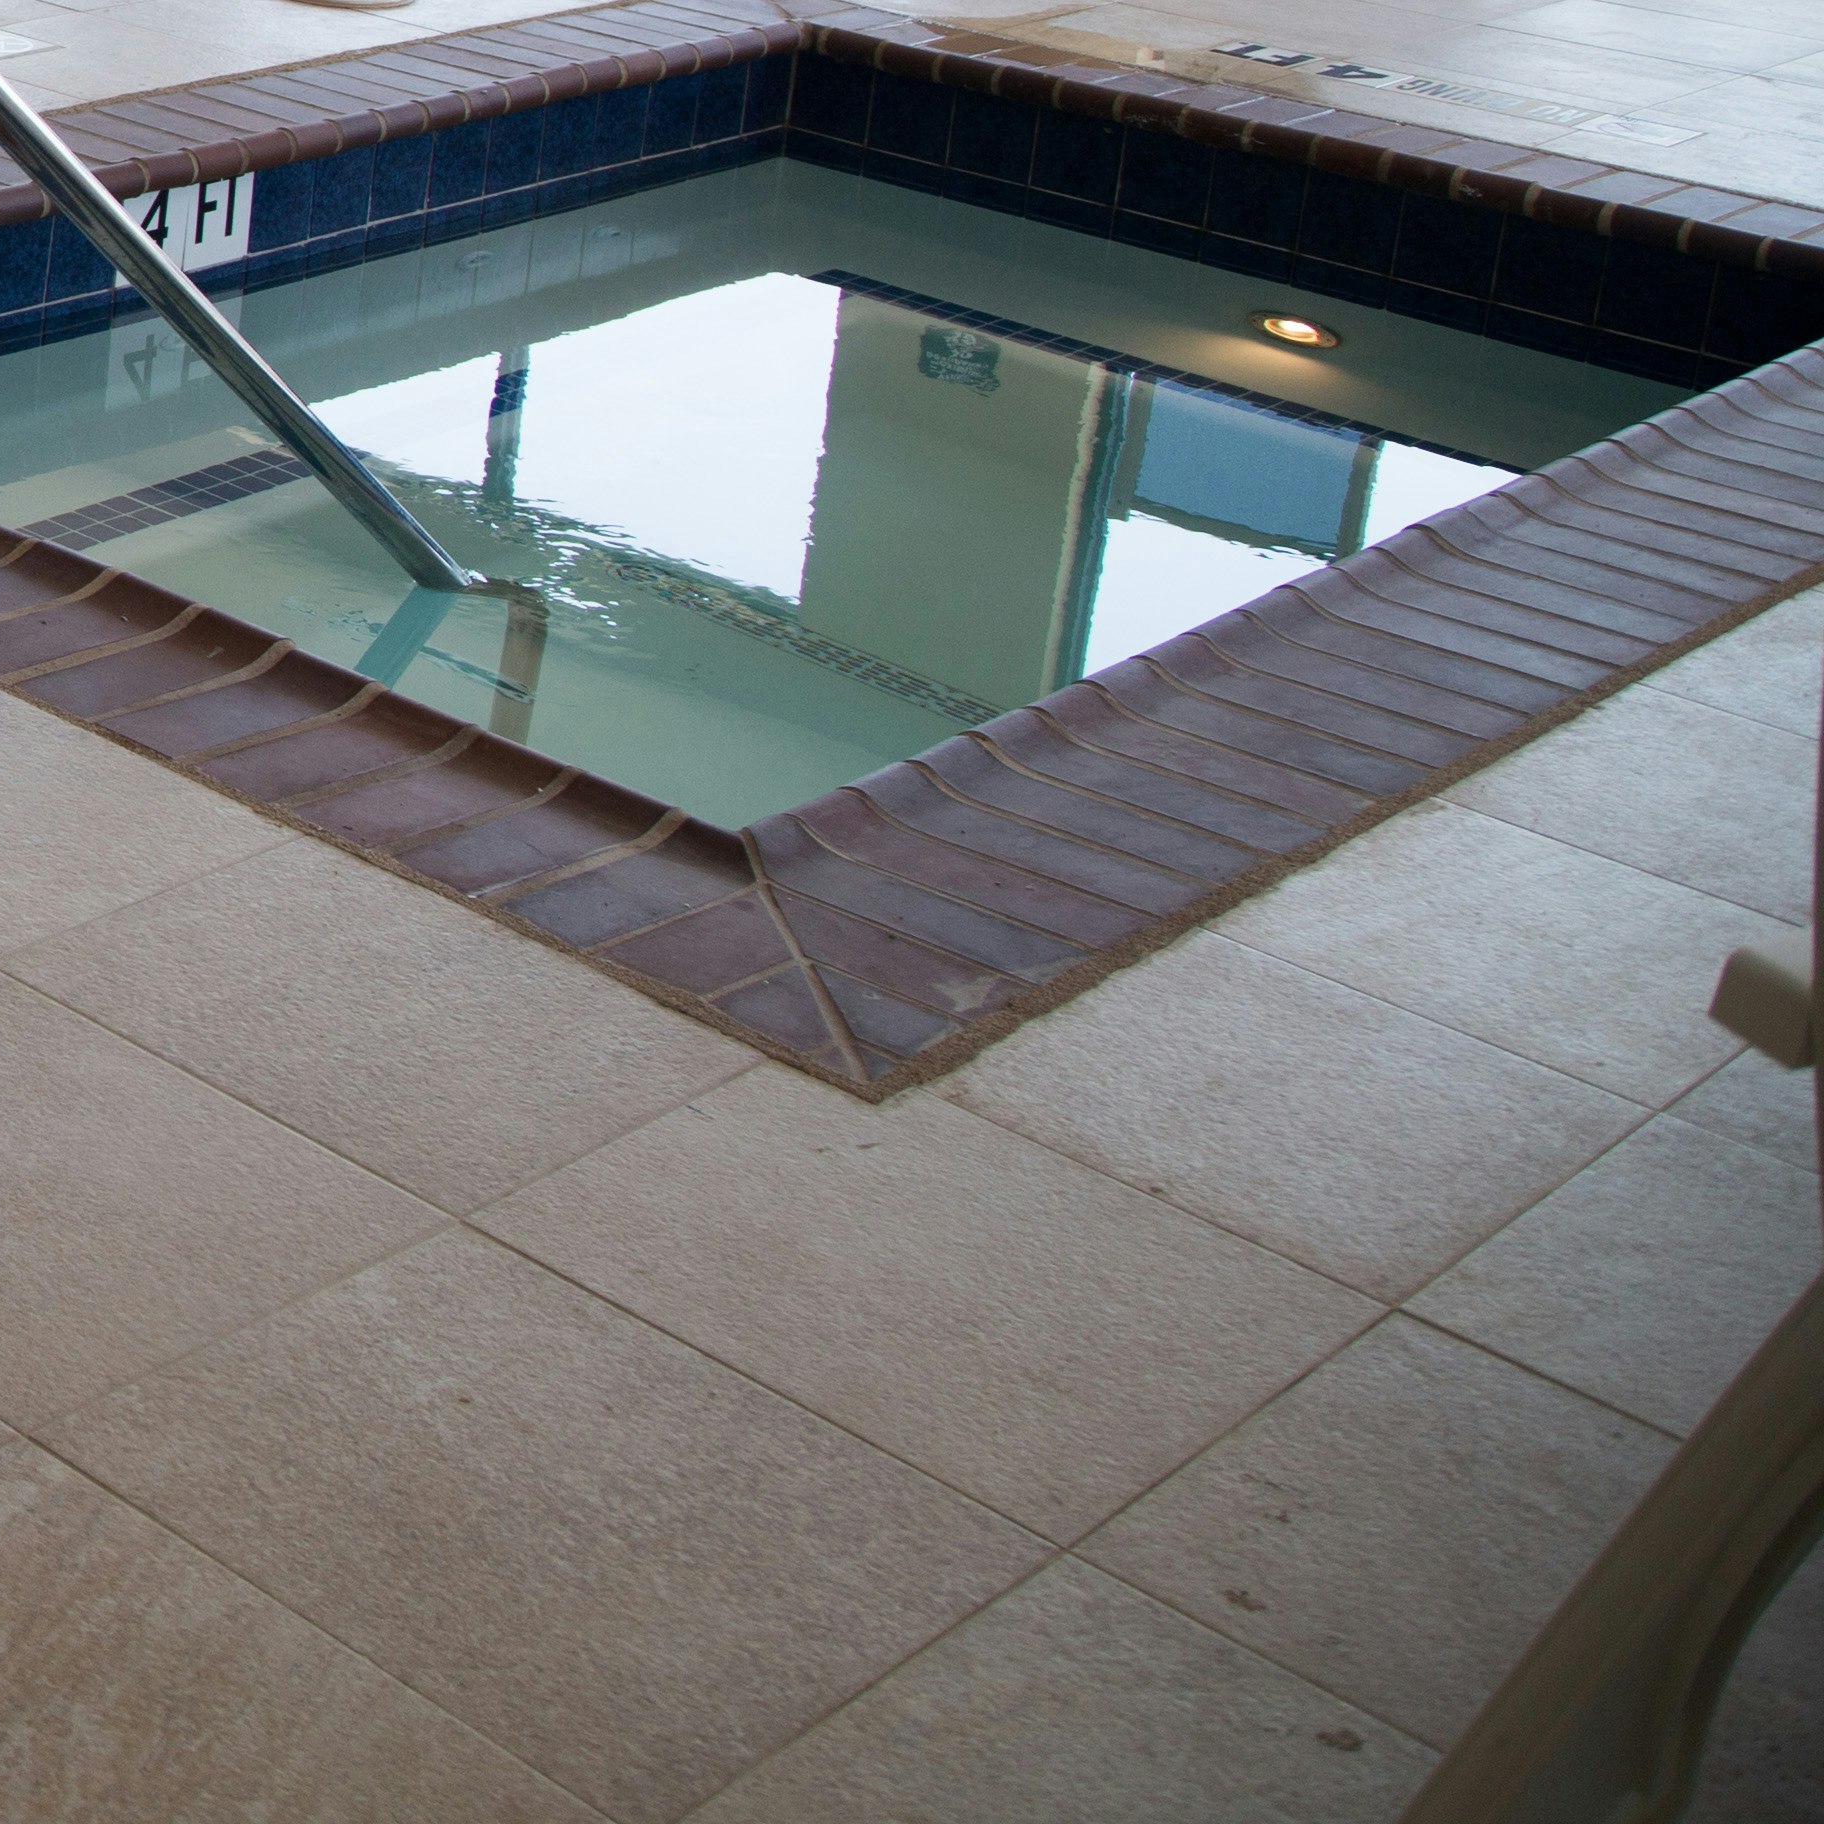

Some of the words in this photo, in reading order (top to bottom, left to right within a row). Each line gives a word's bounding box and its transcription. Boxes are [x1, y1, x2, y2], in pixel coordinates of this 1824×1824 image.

[1315, 64, 1390, 78] 4
[1523, 104, 1592, 123] NO
[141, 188, 169, 250] 4
[194, 177, 237, 244] FT
